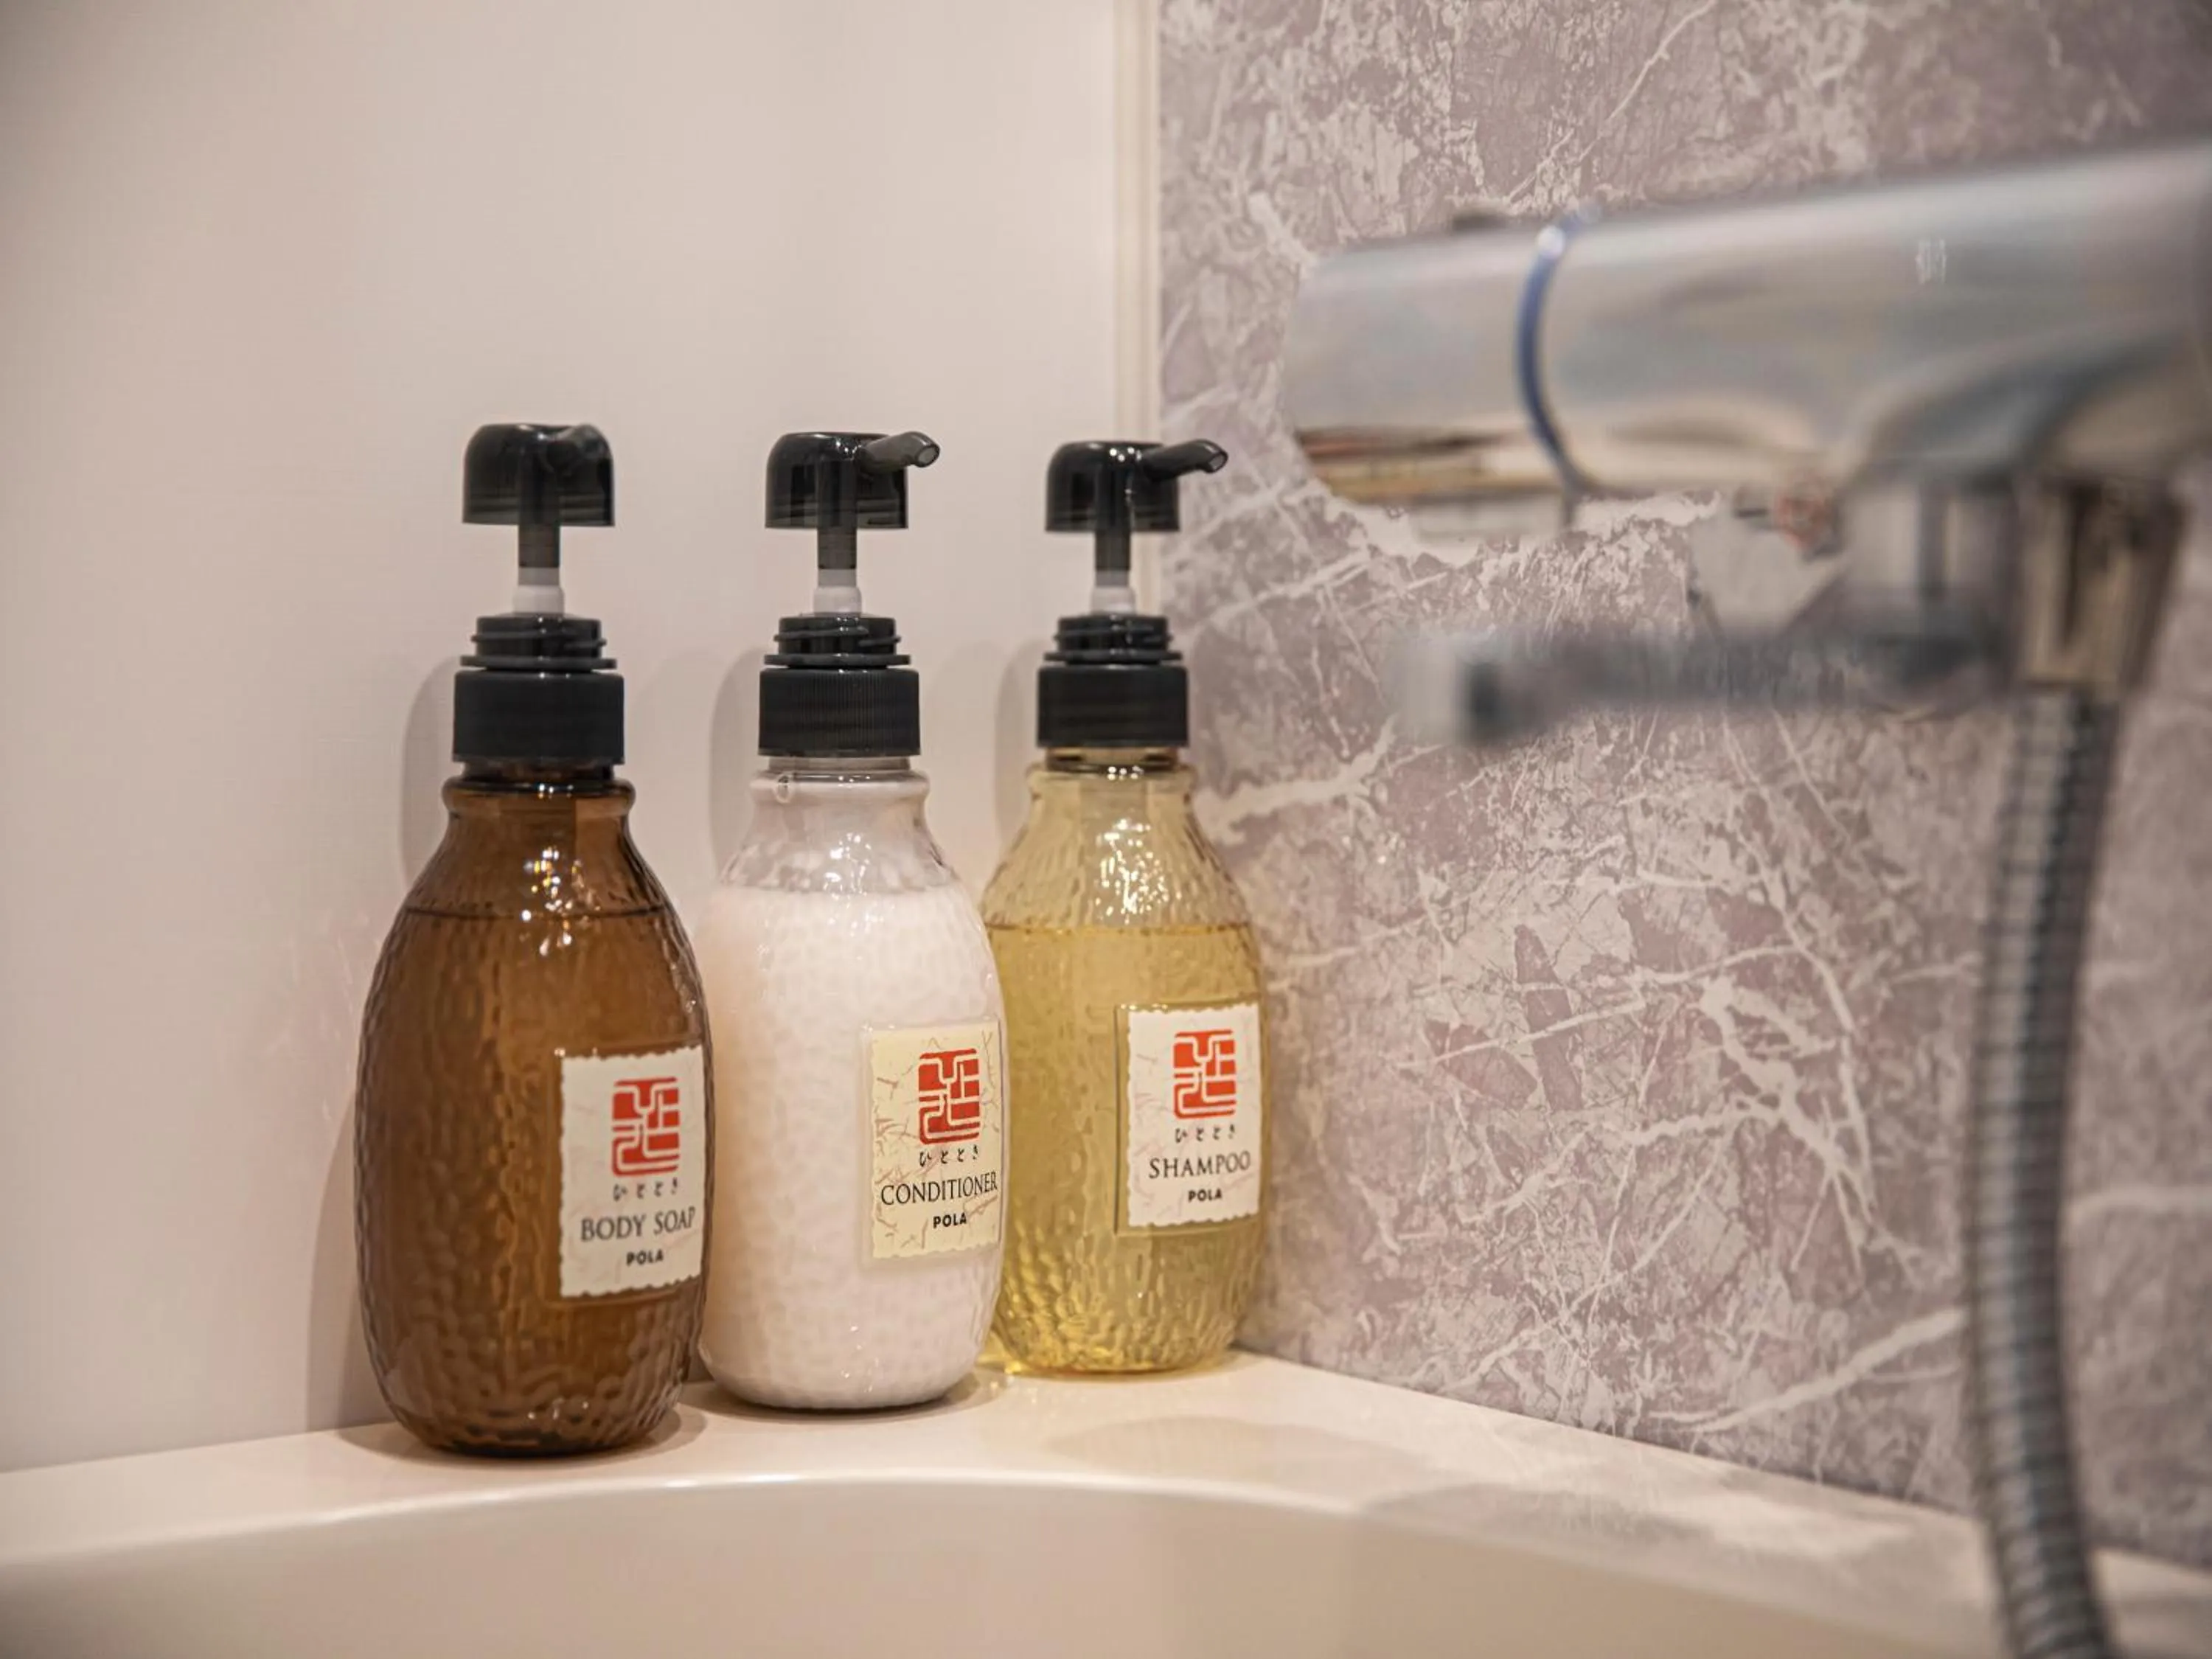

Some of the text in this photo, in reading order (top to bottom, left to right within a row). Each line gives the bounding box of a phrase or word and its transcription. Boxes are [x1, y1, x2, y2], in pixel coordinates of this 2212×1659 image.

[919, 1144, 978, 1167] ひととき
[1149, 1150, 1251, 1179] SHAMPOO
[881, 1171, 998, 1205] CONDITIONER
[1188, 1188, 1222, 1203] POLA
[580, 1206, 696, 1242] BODY SOAP
[933, 1212, 967, 1229] POLA
[626, 1248, 664, 1267] POLA
